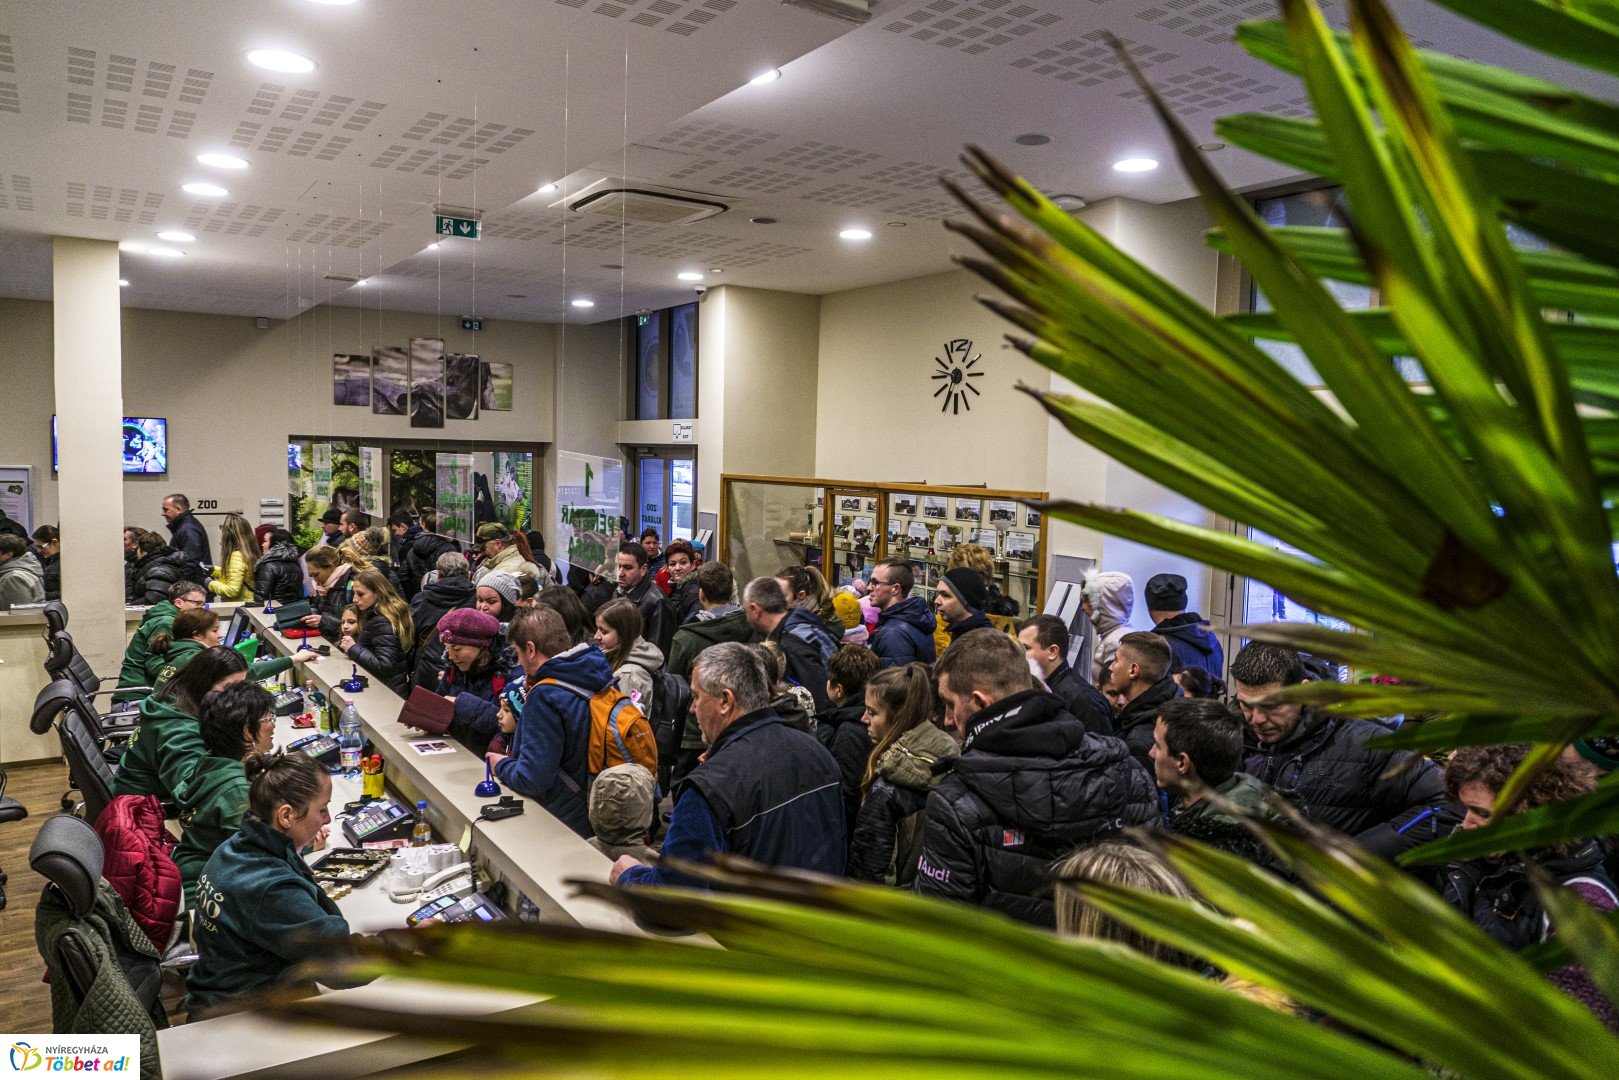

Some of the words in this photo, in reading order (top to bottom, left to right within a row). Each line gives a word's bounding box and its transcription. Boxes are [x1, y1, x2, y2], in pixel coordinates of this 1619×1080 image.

[950, 339, 969, 353] 12
[197, 500, 217, 509] ZOO
[920, 859, 951, 883] Audi
